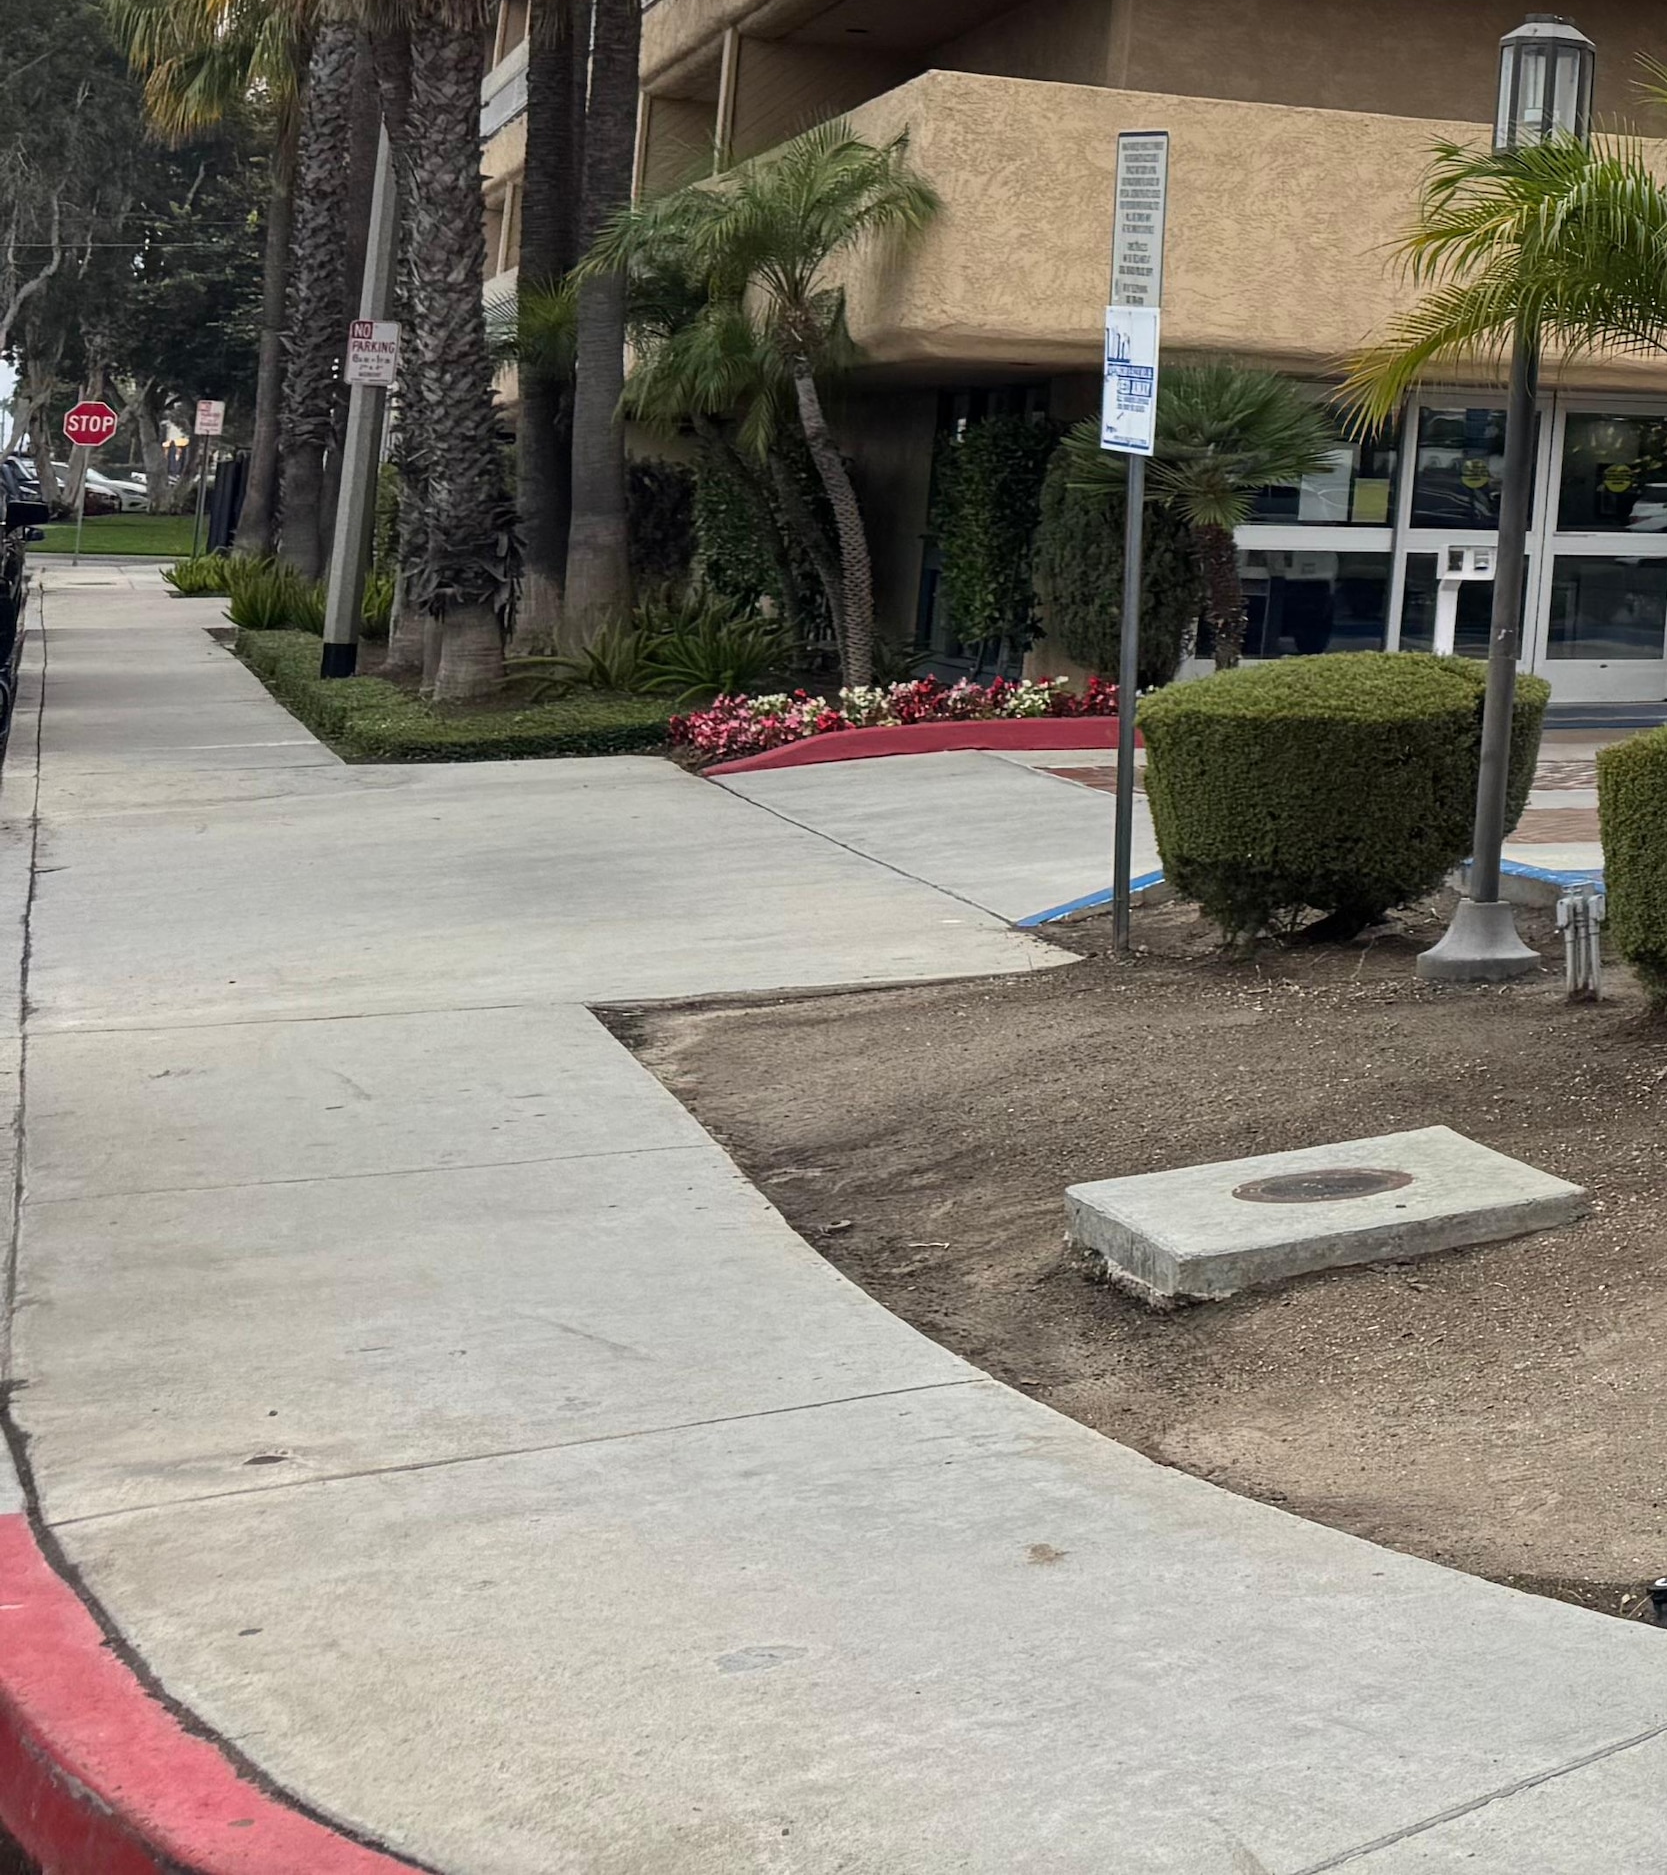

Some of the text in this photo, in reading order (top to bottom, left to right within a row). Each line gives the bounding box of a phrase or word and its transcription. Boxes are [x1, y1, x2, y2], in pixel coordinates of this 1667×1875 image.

[353, 323, 372, 338] NO
[352, 340, 396, 354] PARKING
[67, 415, 114, 432] STOP
